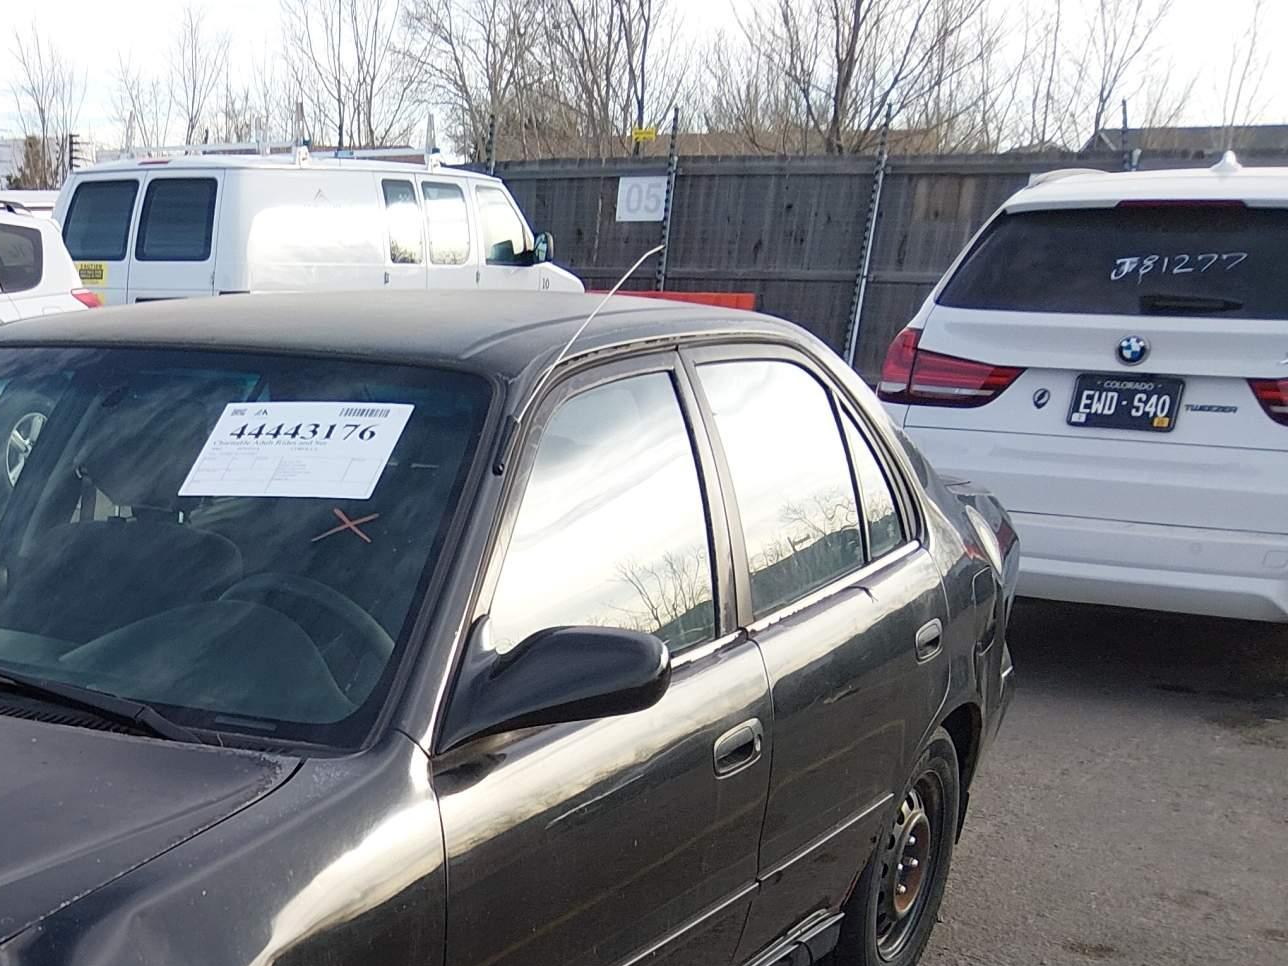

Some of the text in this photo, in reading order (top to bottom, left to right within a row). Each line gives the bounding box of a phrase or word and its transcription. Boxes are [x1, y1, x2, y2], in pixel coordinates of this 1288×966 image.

[625, 182, 661, 214] 05
[1103, 380, 1154, 391] COLORADO
[230, 423, 379, 441] 44443176
